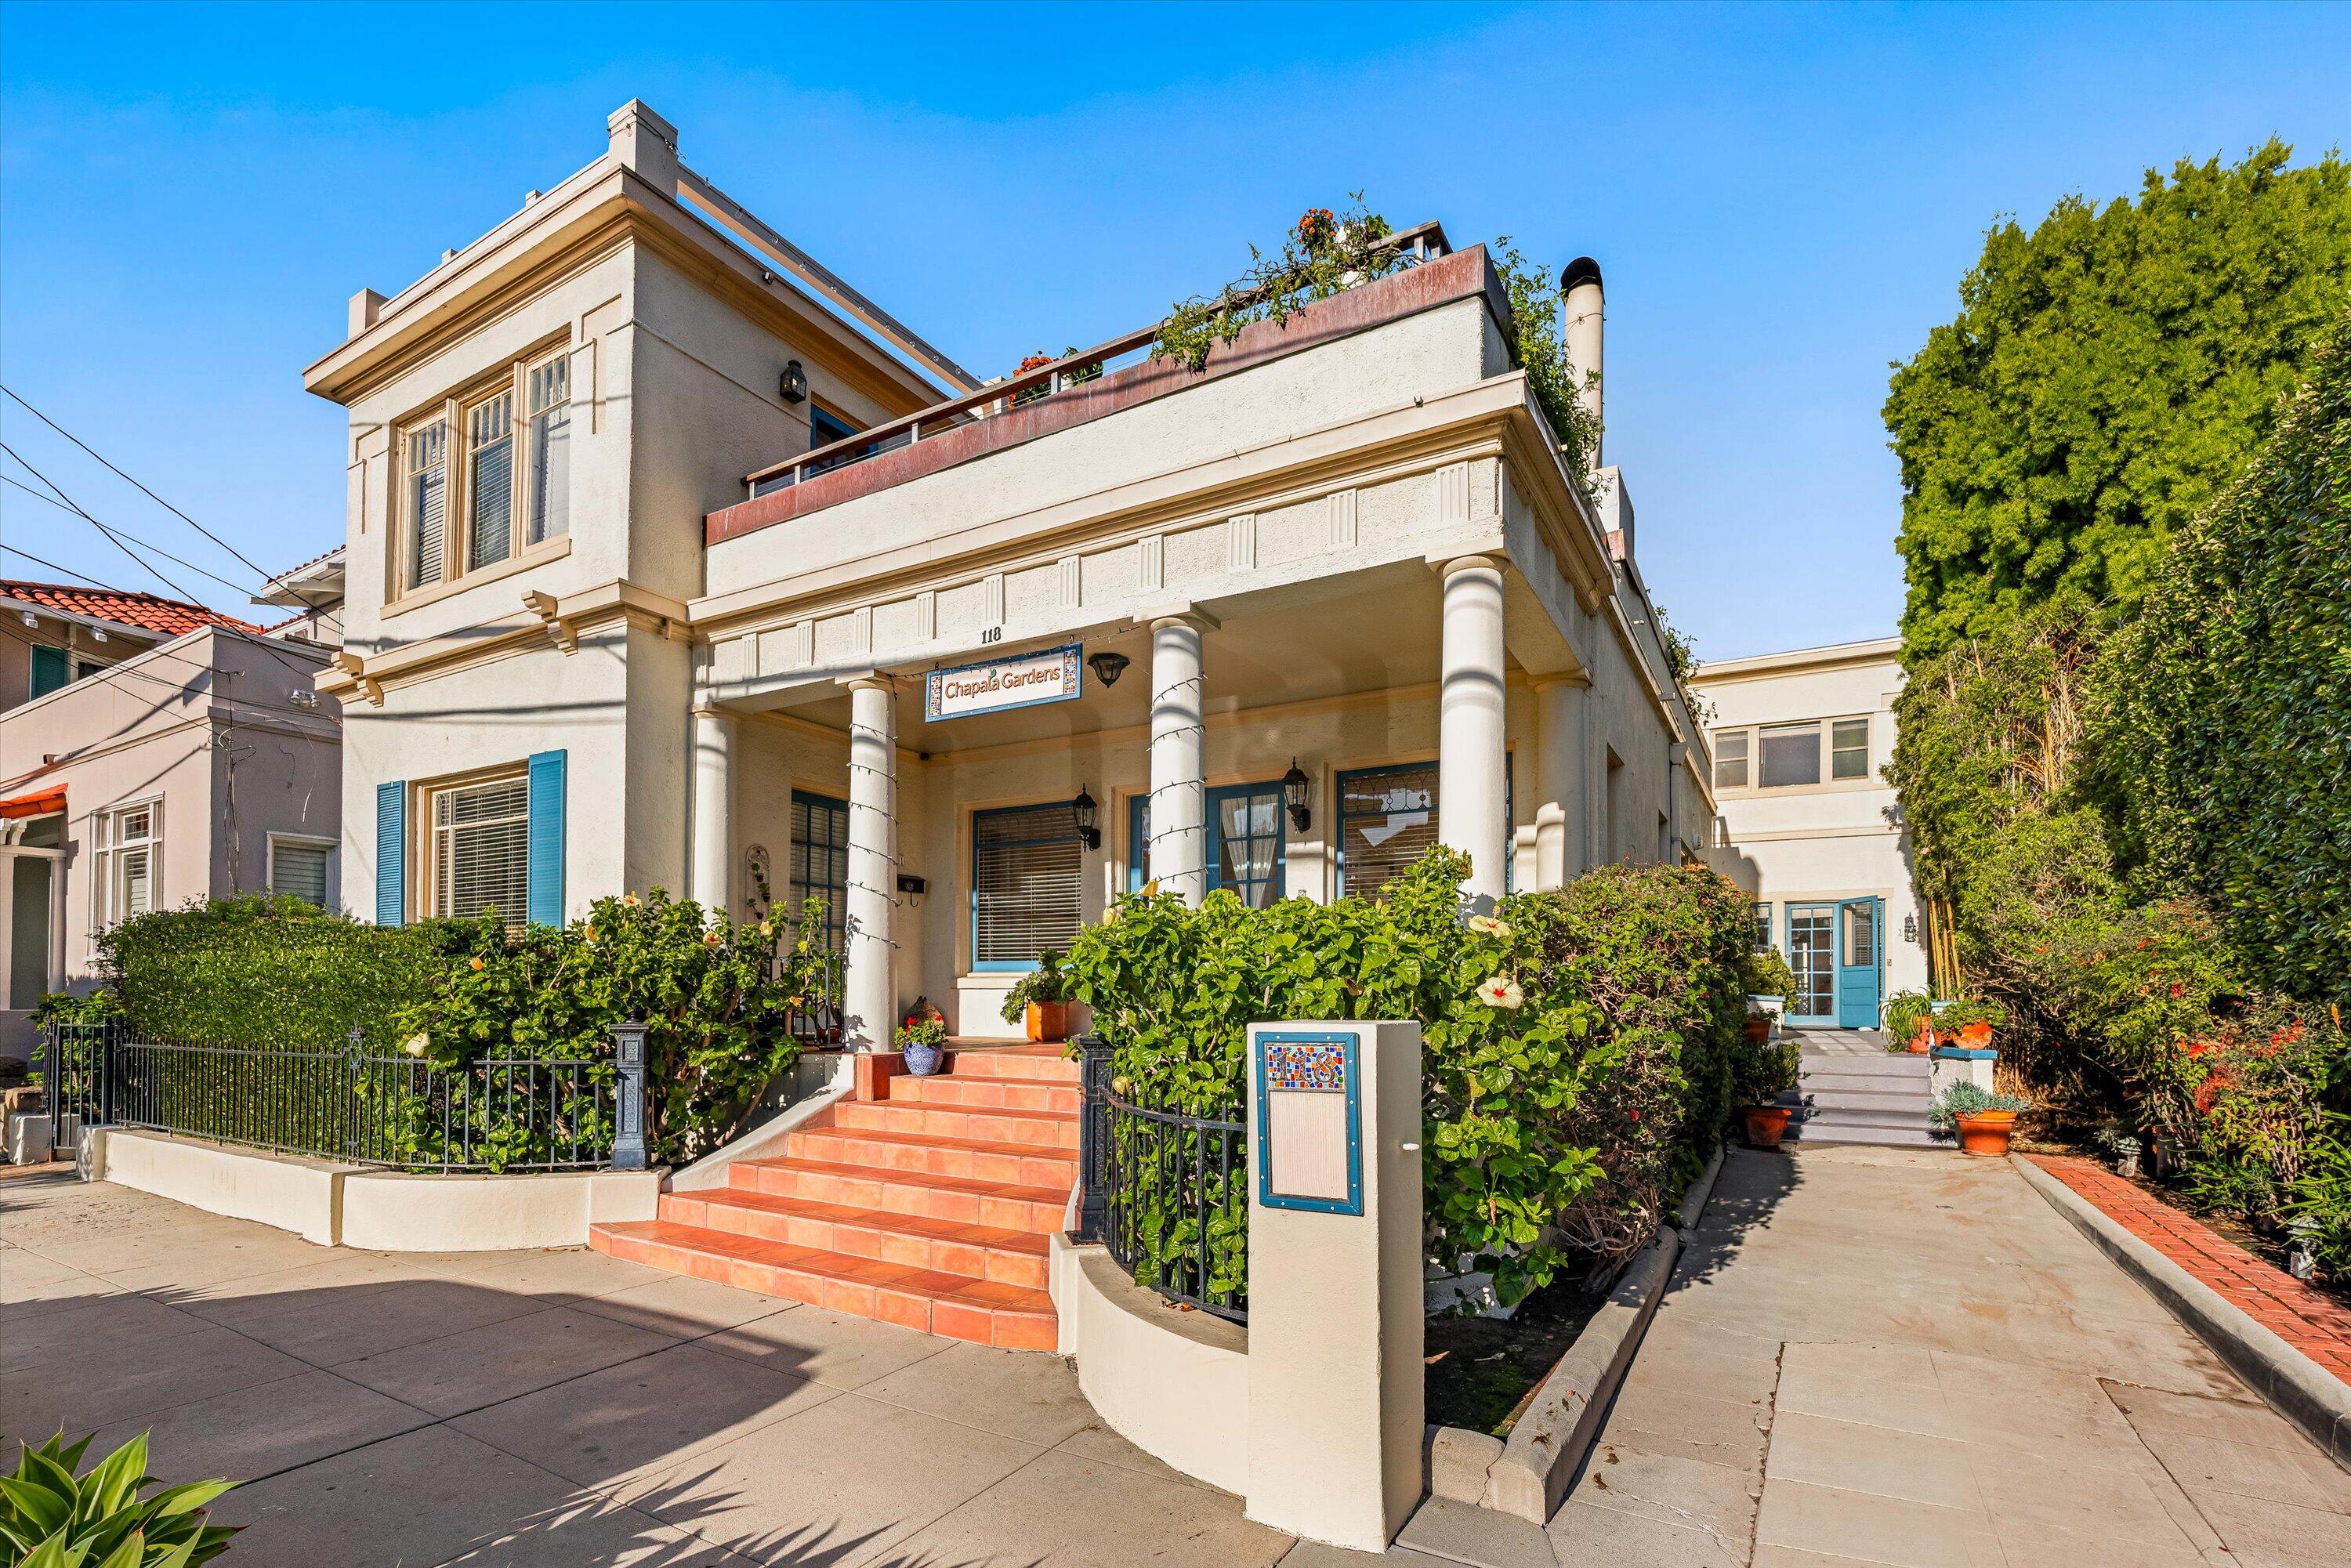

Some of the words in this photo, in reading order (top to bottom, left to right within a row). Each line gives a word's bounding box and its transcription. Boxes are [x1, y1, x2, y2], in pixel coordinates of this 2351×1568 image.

[982, 627, 1001, 643] 118
[945, 675, 1000, 698] Chapala
[1002, 668, 1061, 689] Gardens
[1277, 1052, 1335, 1083] 118
